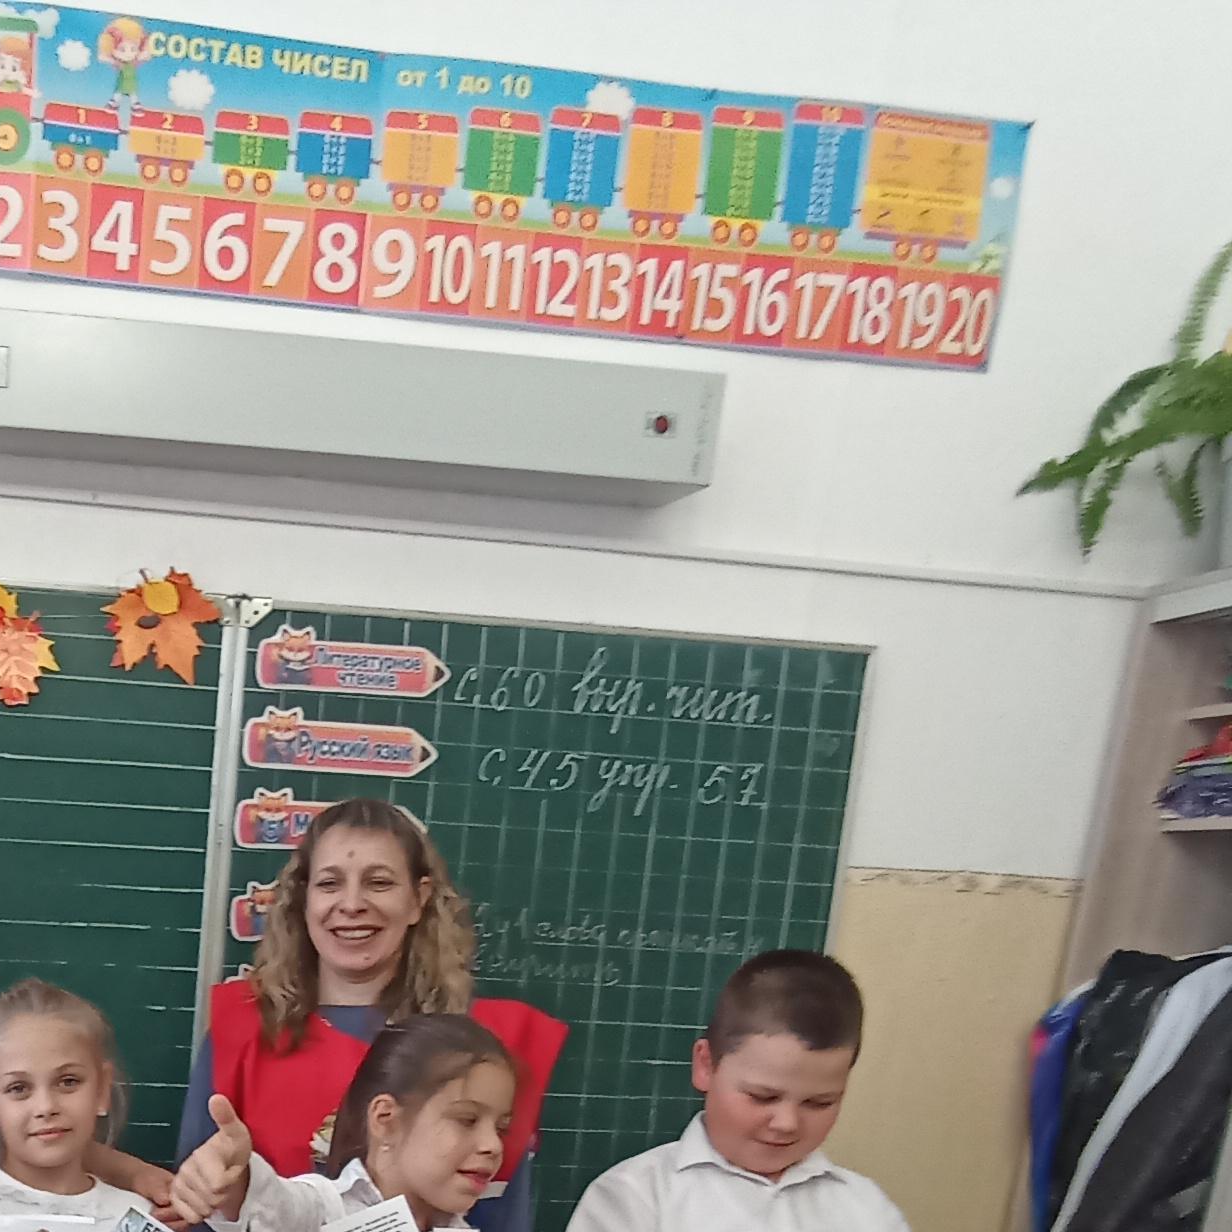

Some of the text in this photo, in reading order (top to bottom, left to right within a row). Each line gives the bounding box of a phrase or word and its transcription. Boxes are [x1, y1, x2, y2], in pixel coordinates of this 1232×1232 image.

[147, 32, 368, 84] СОСТАВ ЧИСЕЛ
[396, 67, 532, 99] от 1 до 10
[76, 108, 87, 124] 1
[162, 113, 174, 129] 2
[246, 114, 259, 131] 3
[330, 115, 343, 131] 4
[417, 112, 429, 130] 5
[499, 111, 512, 128] 6
[581, 112, 593, 128] 7
[742, 109, 755, 126] 9
[36, 190, 81, 262] 3
[90, 200, 139, 272] 4
[149, 206, 193, 277] 5
[203, 212, 250, 282] 6
[261, 218, 306, 287] 7
[312, 222, 359, 294] 8
[371, 228, 417, 299] 9
[424, 234, 472, 304] 10
[481, 240, 527, 310] 11
[531, 247, 577, 317] 12
[584, 252, 631, 323] 13
[637, 257, 683, 328] 14
[690, 261, 737, 333] 15
[741, 267, 791, 340] 16
[794, 272, 846, 345] 17
[845, 276, 894, 346] 18
[896, 280, 944, 350] 19
[941, 286, 993, 357] 20
[317, 648, 423, 672] Литературное
[296, 730, 414, 764] Русский язык
[518, 749, 588, 791] 45
